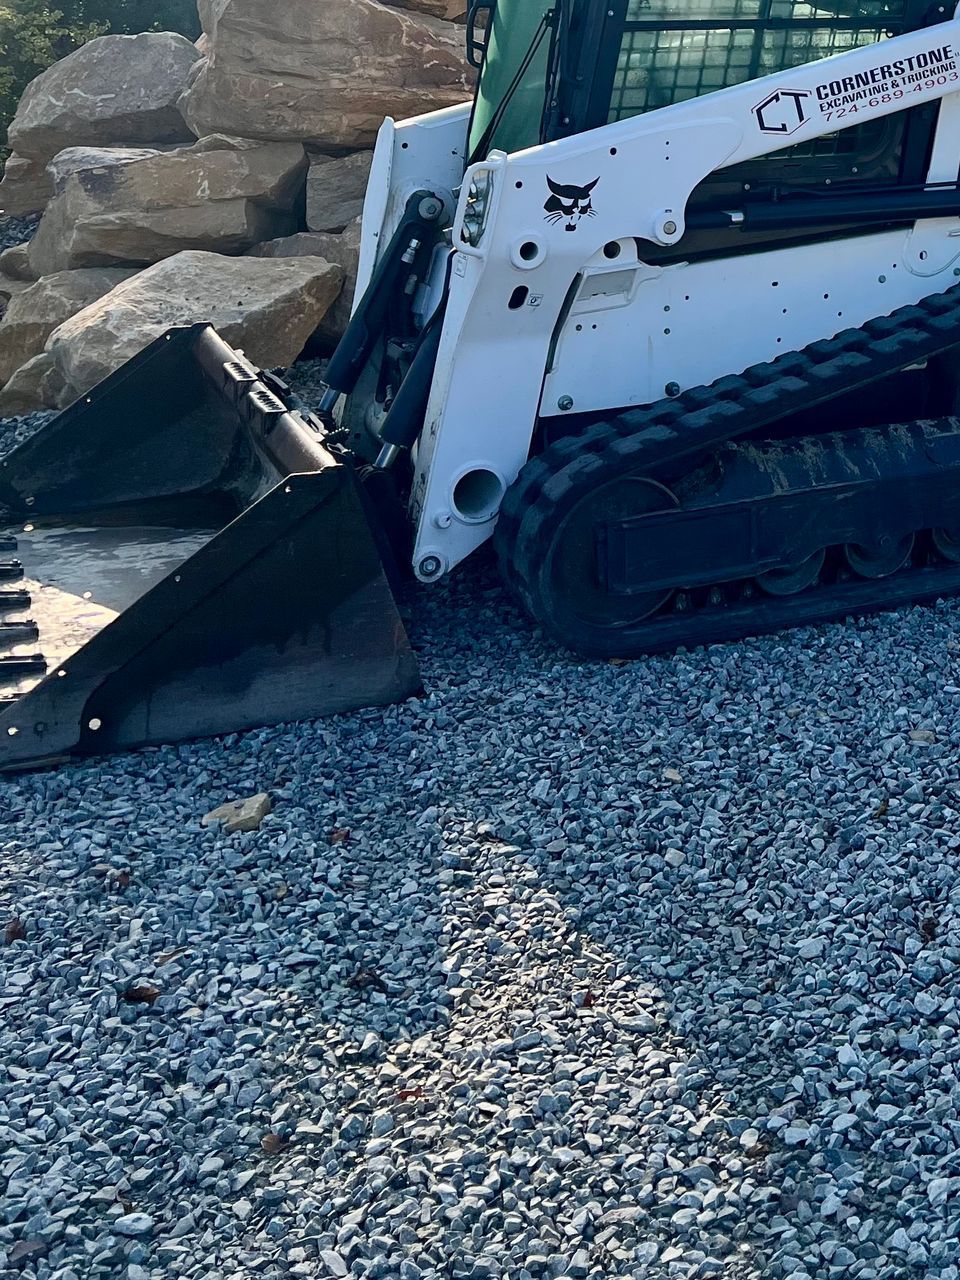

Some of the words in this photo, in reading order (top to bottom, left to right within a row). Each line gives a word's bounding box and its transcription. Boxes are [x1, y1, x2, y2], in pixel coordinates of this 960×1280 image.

[815, 44, 954, 101] CORNERSTONE
[819, 82, 889, 112] EXCAVATING
[890, 77, 900, 89] &
[901, 61, 957, 87] TRUCKING
[823, 71, 960, 122] 724-689-4903
[755, 91, 809, 133] CT
